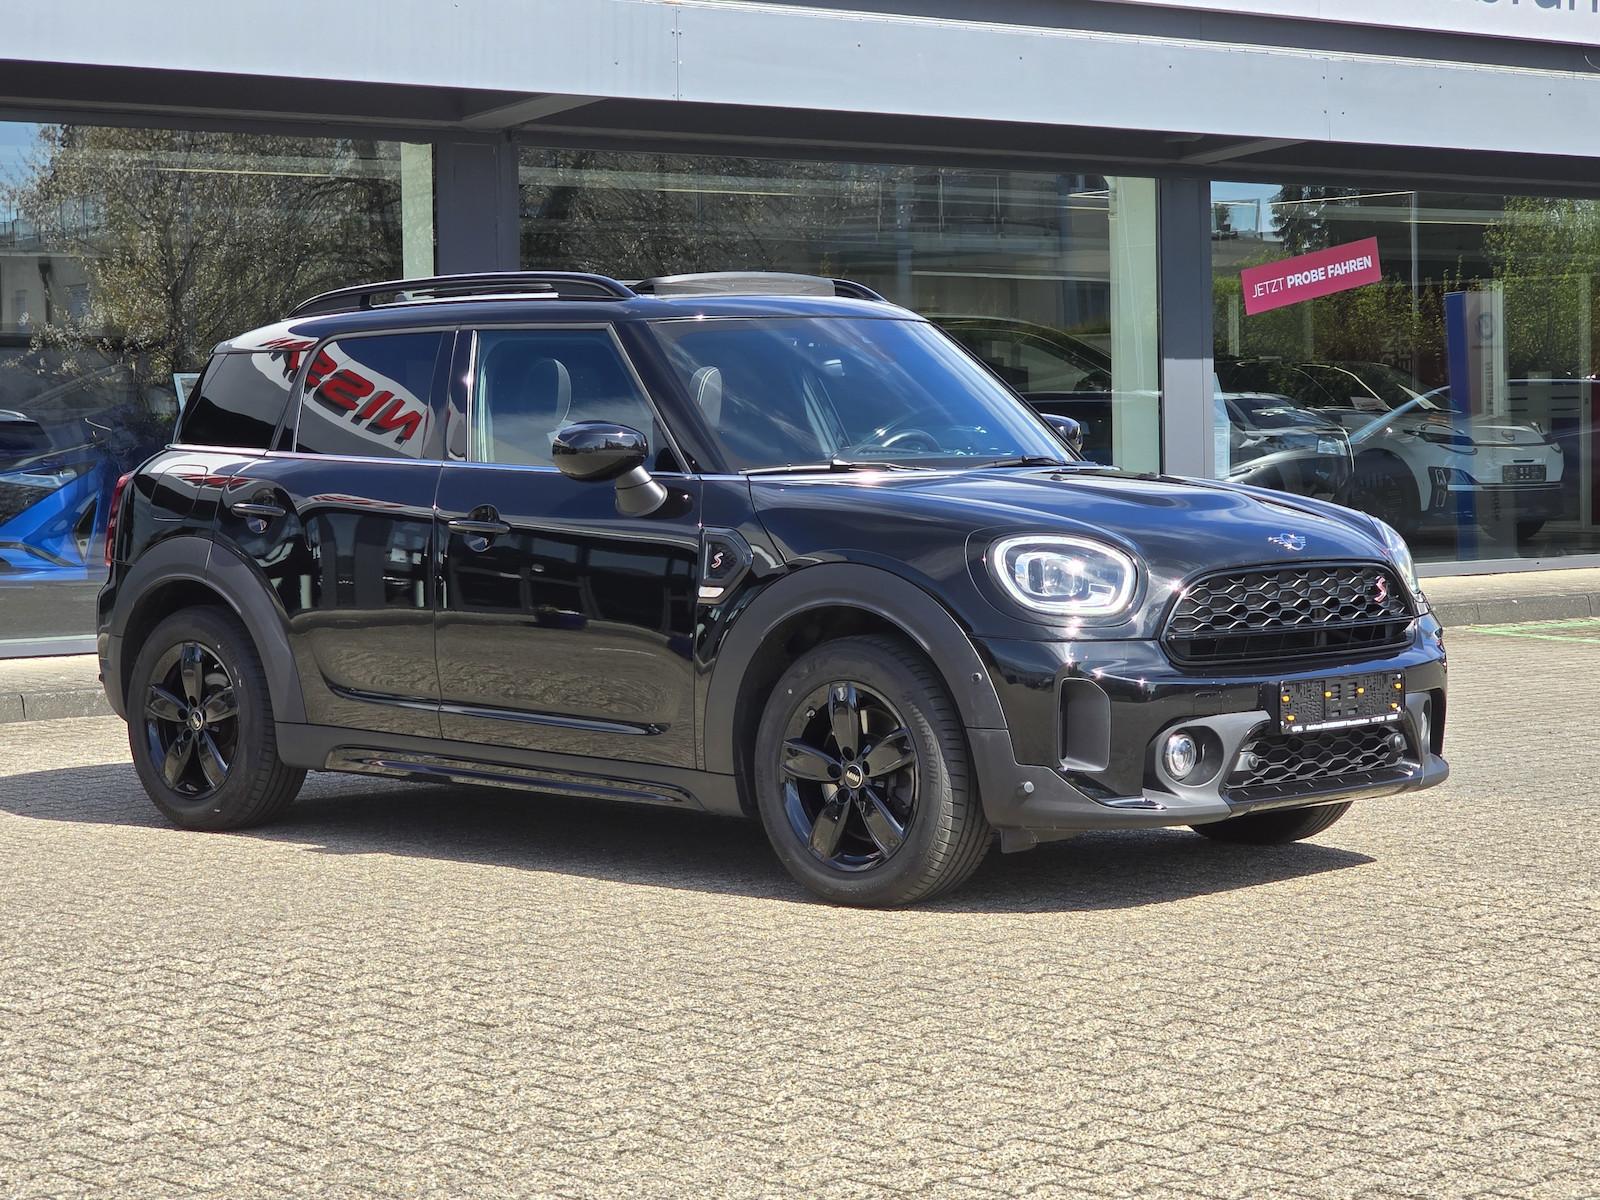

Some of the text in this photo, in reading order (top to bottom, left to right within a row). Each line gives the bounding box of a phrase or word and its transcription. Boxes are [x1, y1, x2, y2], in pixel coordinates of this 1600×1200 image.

[1252, 255, 1372, 298] JETZT PROBE FAHREN
[711, 552, 724, 569] S
[1374, 575, 1386, 603] S
